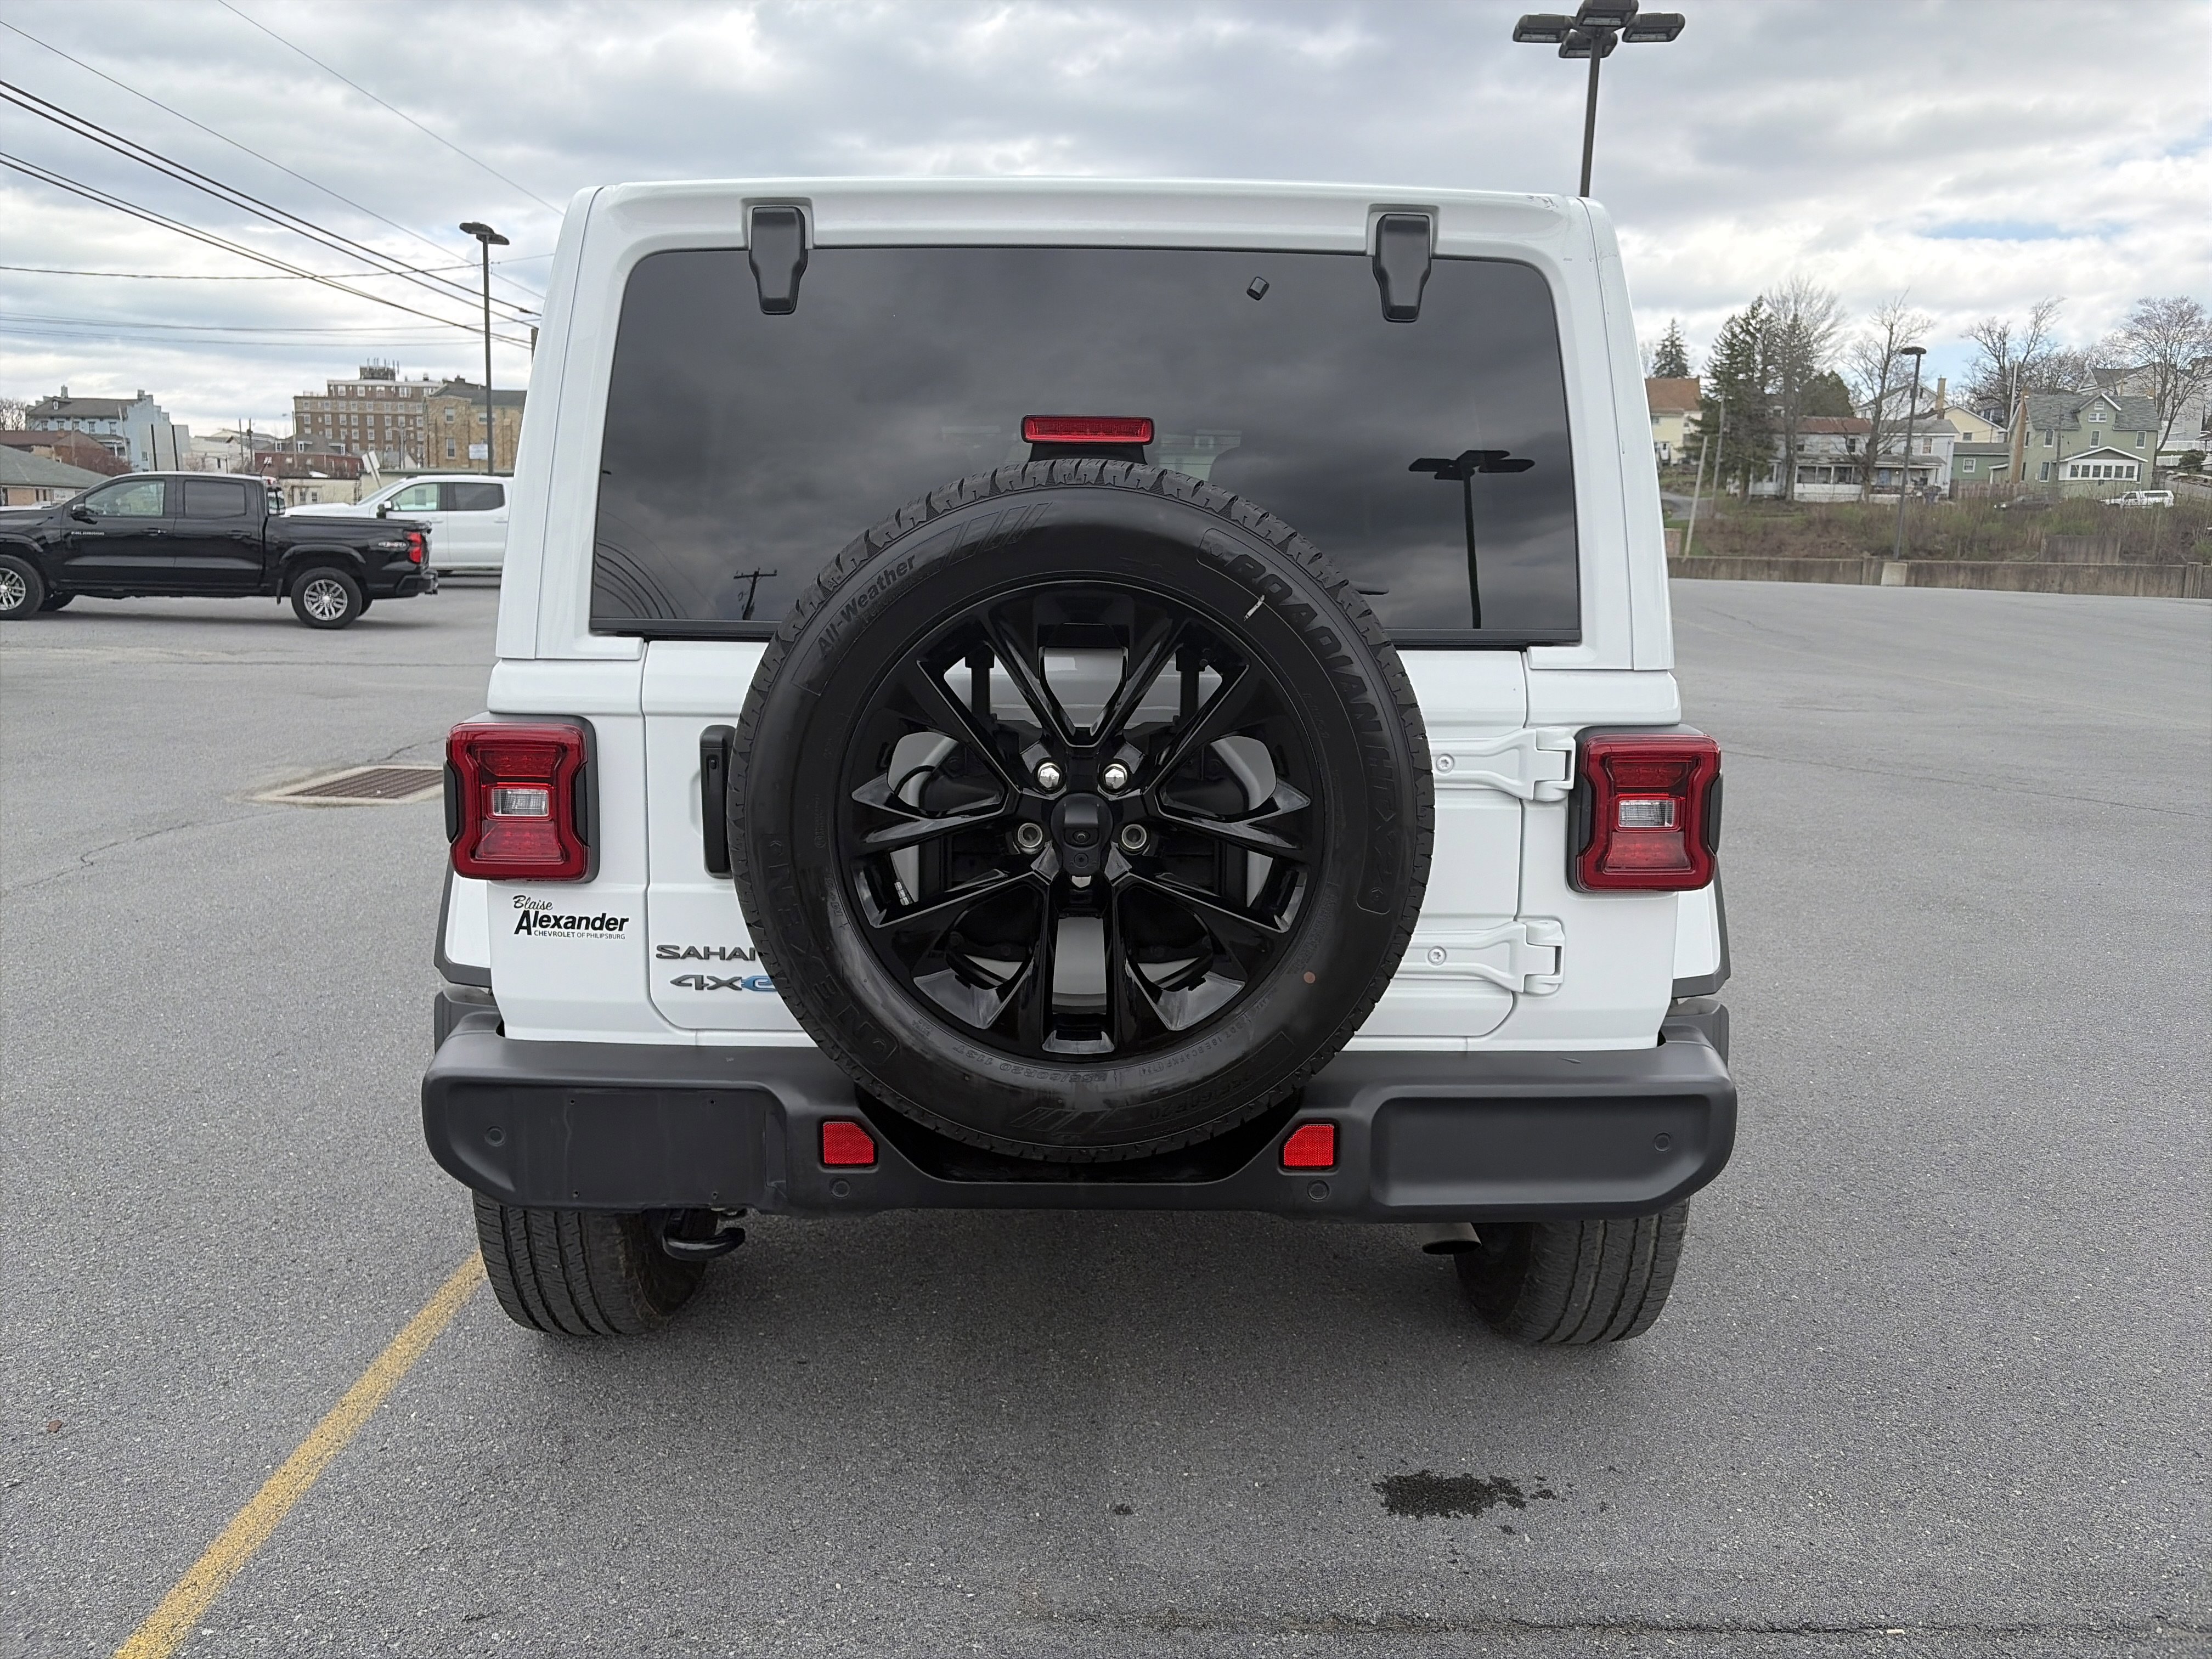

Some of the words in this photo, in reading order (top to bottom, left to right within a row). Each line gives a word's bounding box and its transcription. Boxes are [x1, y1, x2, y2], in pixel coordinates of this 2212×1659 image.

[816, 552, 917, 653] All-Weather
[1224, 551, 1383, 733] ROADIAN
[512, 895, 553, 910] Blaise
[514, 910, 629, 935] Alexander
[534, 930, 575, 938] CHEVROLET
[766, 862, 875, 1044] NEXEN
